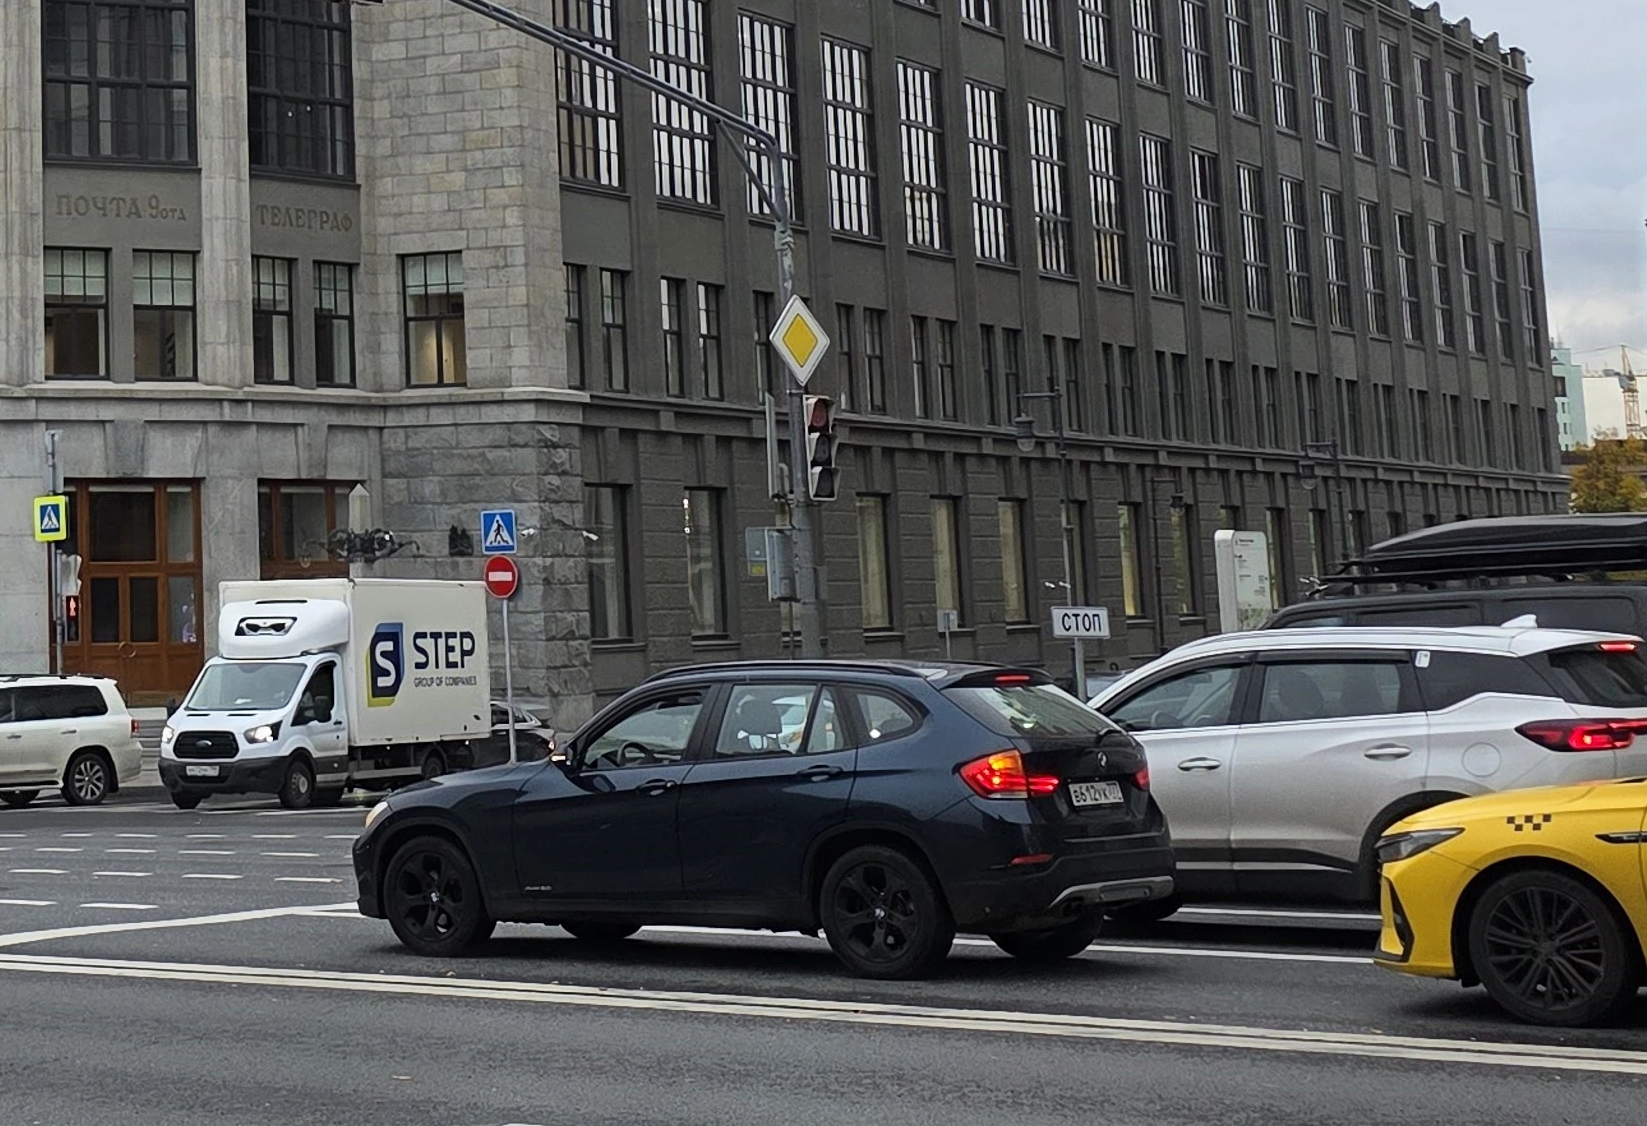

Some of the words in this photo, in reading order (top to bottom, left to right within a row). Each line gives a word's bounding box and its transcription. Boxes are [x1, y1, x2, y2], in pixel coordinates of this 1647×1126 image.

[56, 194, 142, 219] ПОЧТА
[256, 204, 353, 233] ТЕЛЕГРАФ
[1061, 612, 1102, 632] СТОП
[413, 631, 475, 669] STEP
[414, 677, 434, 688] GROUP
[435, 677, 443, 687] OF
[444, 675, 477, 686] COMPANIES
